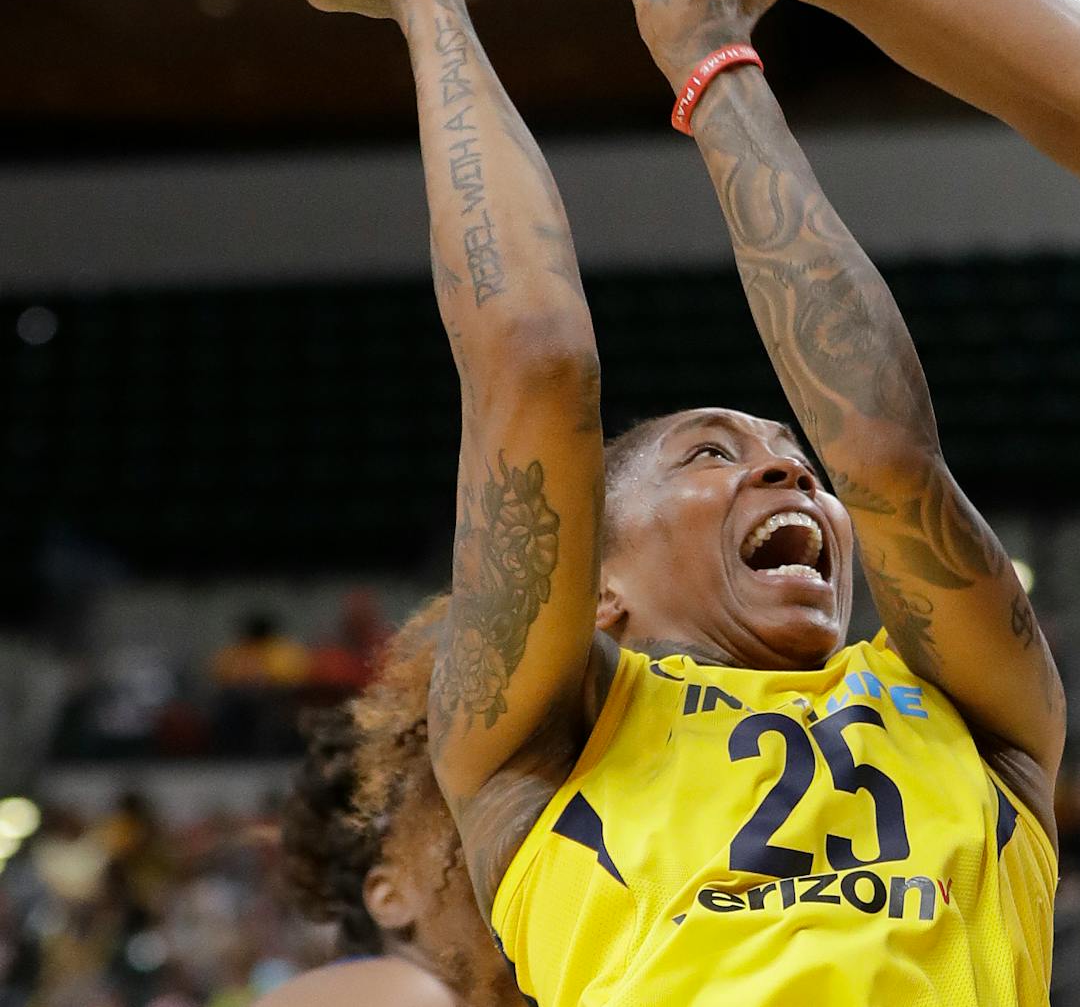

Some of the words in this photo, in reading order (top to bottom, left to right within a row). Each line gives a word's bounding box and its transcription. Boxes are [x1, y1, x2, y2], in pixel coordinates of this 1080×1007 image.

[442, 105, 477, 133] A
[464, 209, 507, 308] REBEL
[728, 704, 911, 879] 25
[672, 870, 937, 926] erizon
